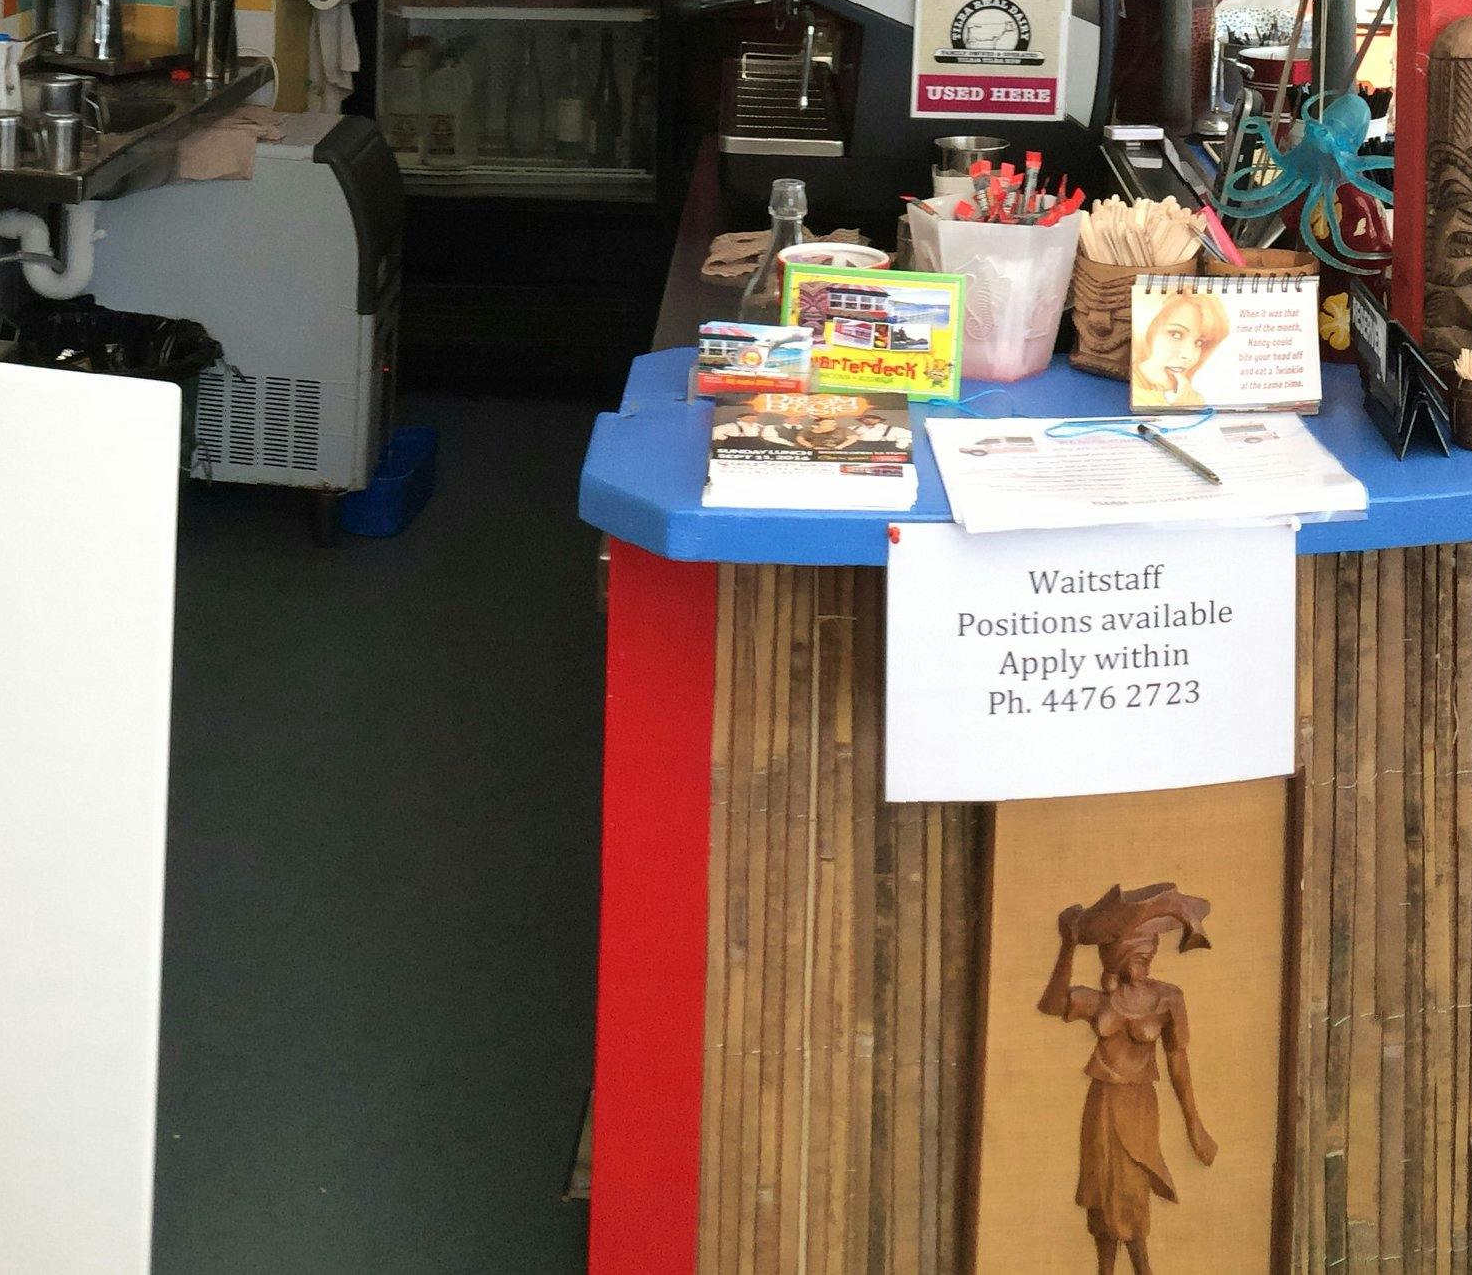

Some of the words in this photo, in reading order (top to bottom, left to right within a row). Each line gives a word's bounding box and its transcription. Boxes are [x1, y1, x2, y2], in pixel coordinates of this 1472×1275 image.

[951, 6, 975, 41] TILBA
[925, 85, 986, 101] USED
[989, 87, 1052, 103] HERE
[1027, 563, 1166, 596] Waitstaff
[956, 609, 1093, 638] Positions
[1100, 600, 1234, 632] available
[998, 647, 1087, 682] Apply
[1094, 643, 1190, 672] within
[987, 689, 1033, 716] Ph.
[1040, 685, 1117, 713] 4476
[1124, 679, 1202, 710] 2723
